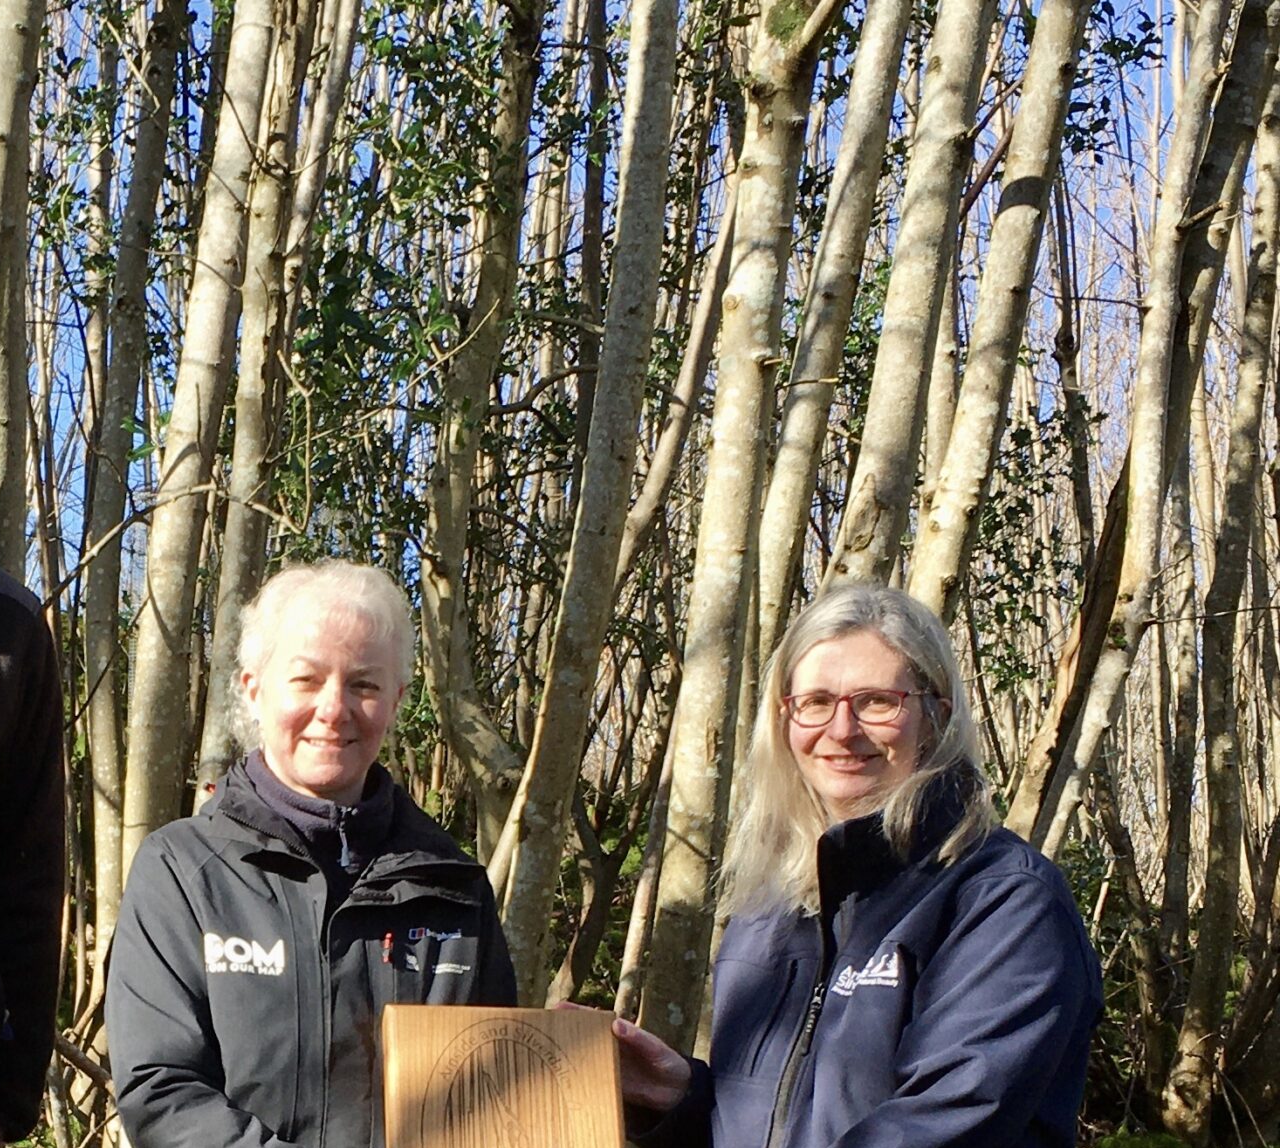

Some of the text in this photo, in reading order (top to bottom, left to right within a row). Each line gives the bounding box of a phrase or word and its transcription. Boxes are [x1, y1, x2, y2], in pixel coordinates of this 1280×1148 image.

[229, 963, 255, 973] OUR
[258, 967, 284, 976] MAP
[439, 1024, 572, 1088] Arnside and Silverdale
